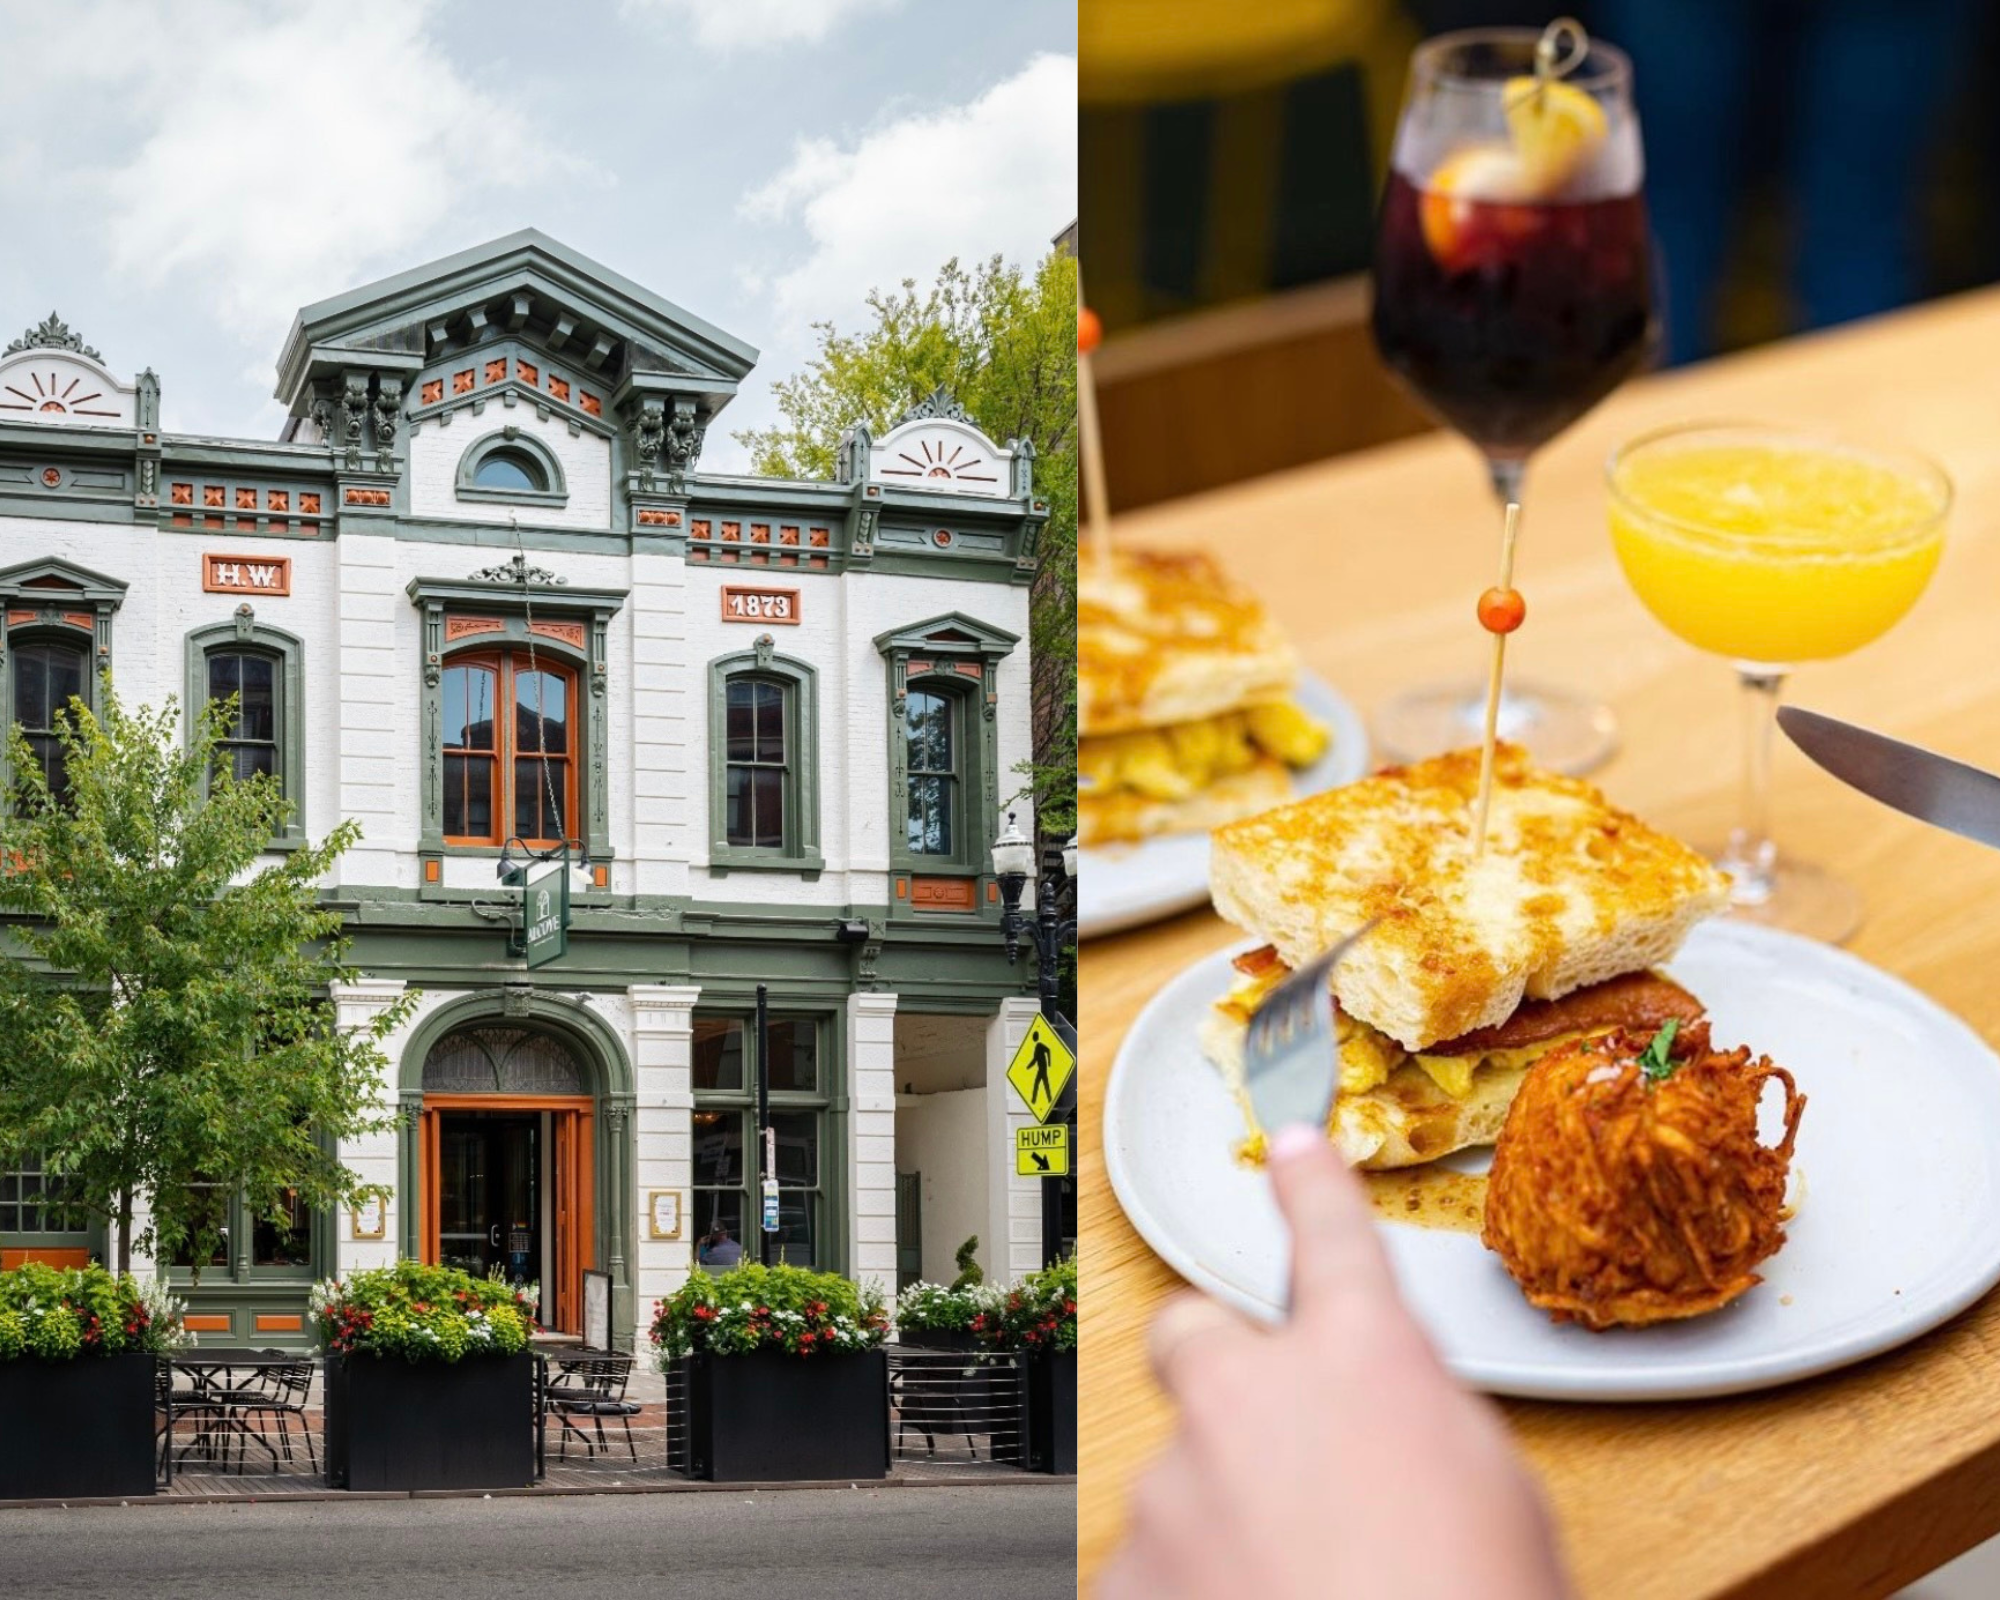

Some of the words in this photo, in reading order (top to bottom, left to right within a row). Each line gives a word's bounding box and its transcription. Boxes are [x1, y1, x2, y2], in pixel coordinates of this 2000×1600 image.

[218, 563, 276, 587] H.W.
[731, 594, 789, 618] 1873
[1021, 1129, 1061, 1147] HUMP
